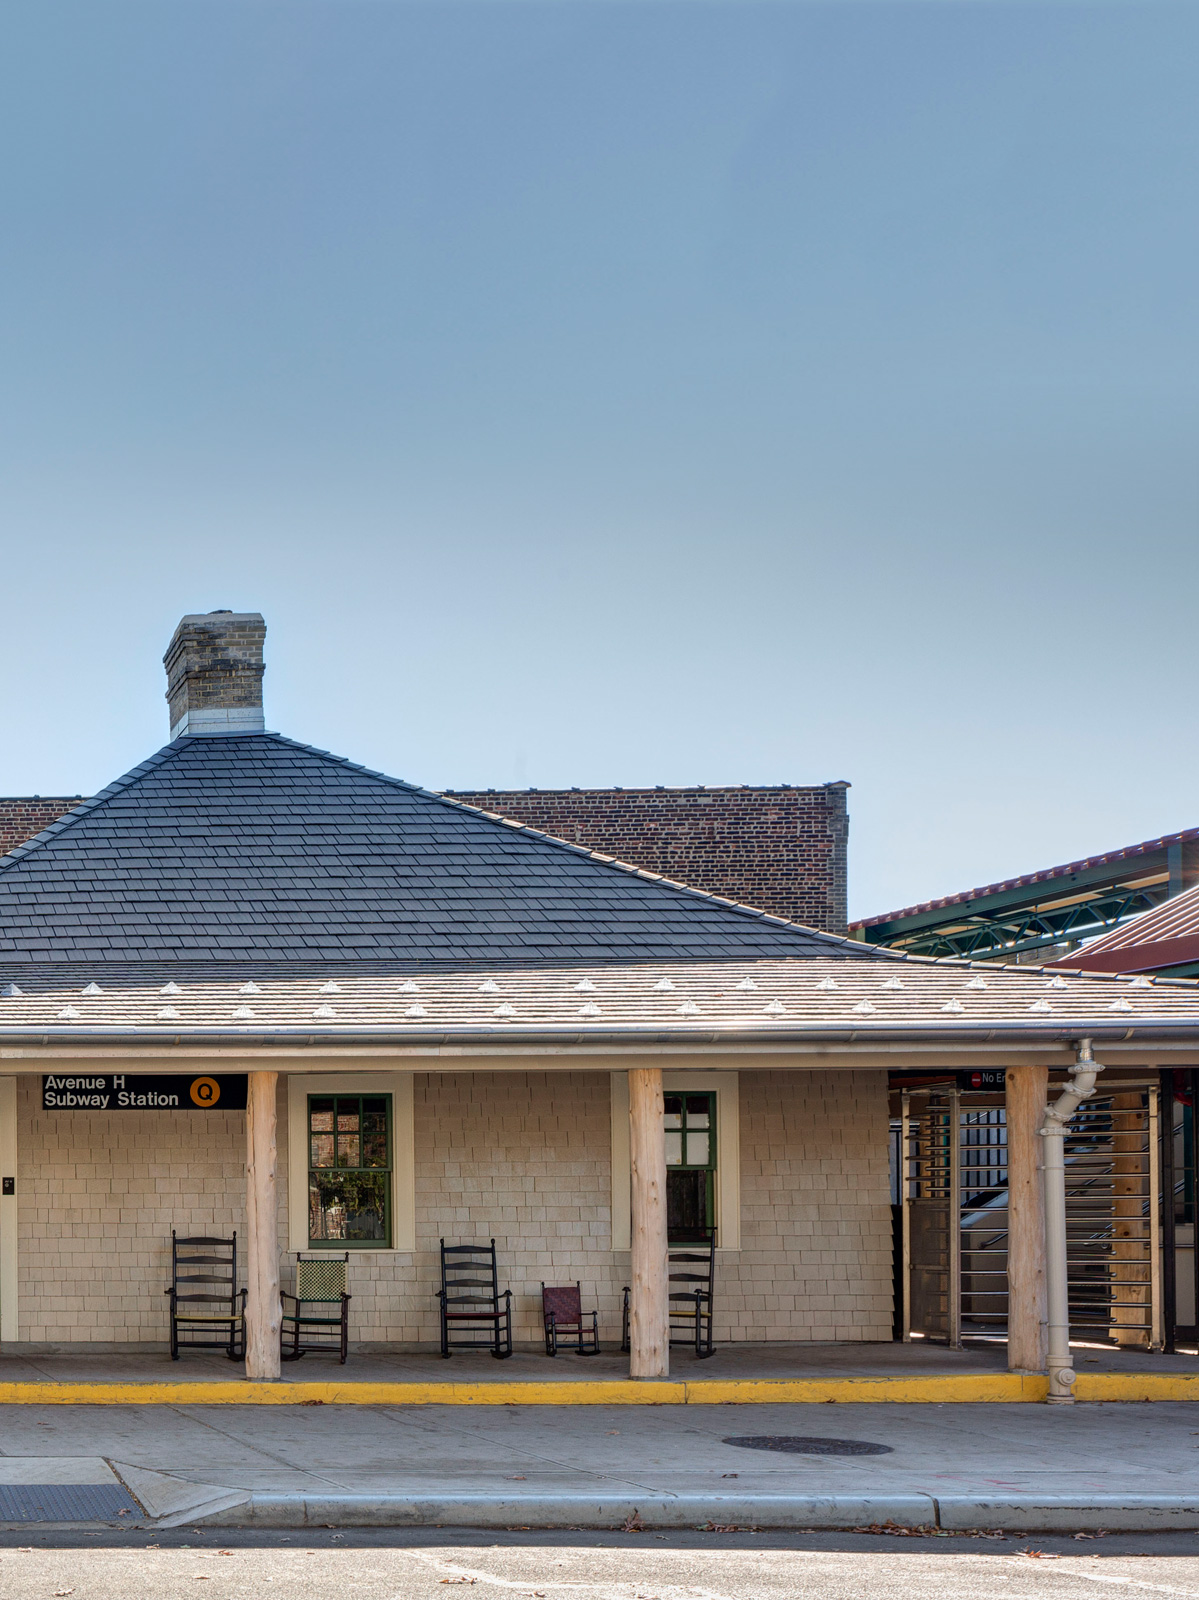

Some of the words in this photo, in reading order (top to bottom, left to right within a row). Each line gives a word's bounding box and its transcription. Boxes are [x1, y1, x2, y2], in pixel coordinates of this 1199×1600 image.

[45, 1075, 105, 1089] Avenue
[113, 1075, 125, 1089] H
[982, 1072, 994, 1083] No
[44, 1092, 110, 1109] Subway
[117, 1091, 179, 1106] Station
[197, 1083, 213, 1101] Q
